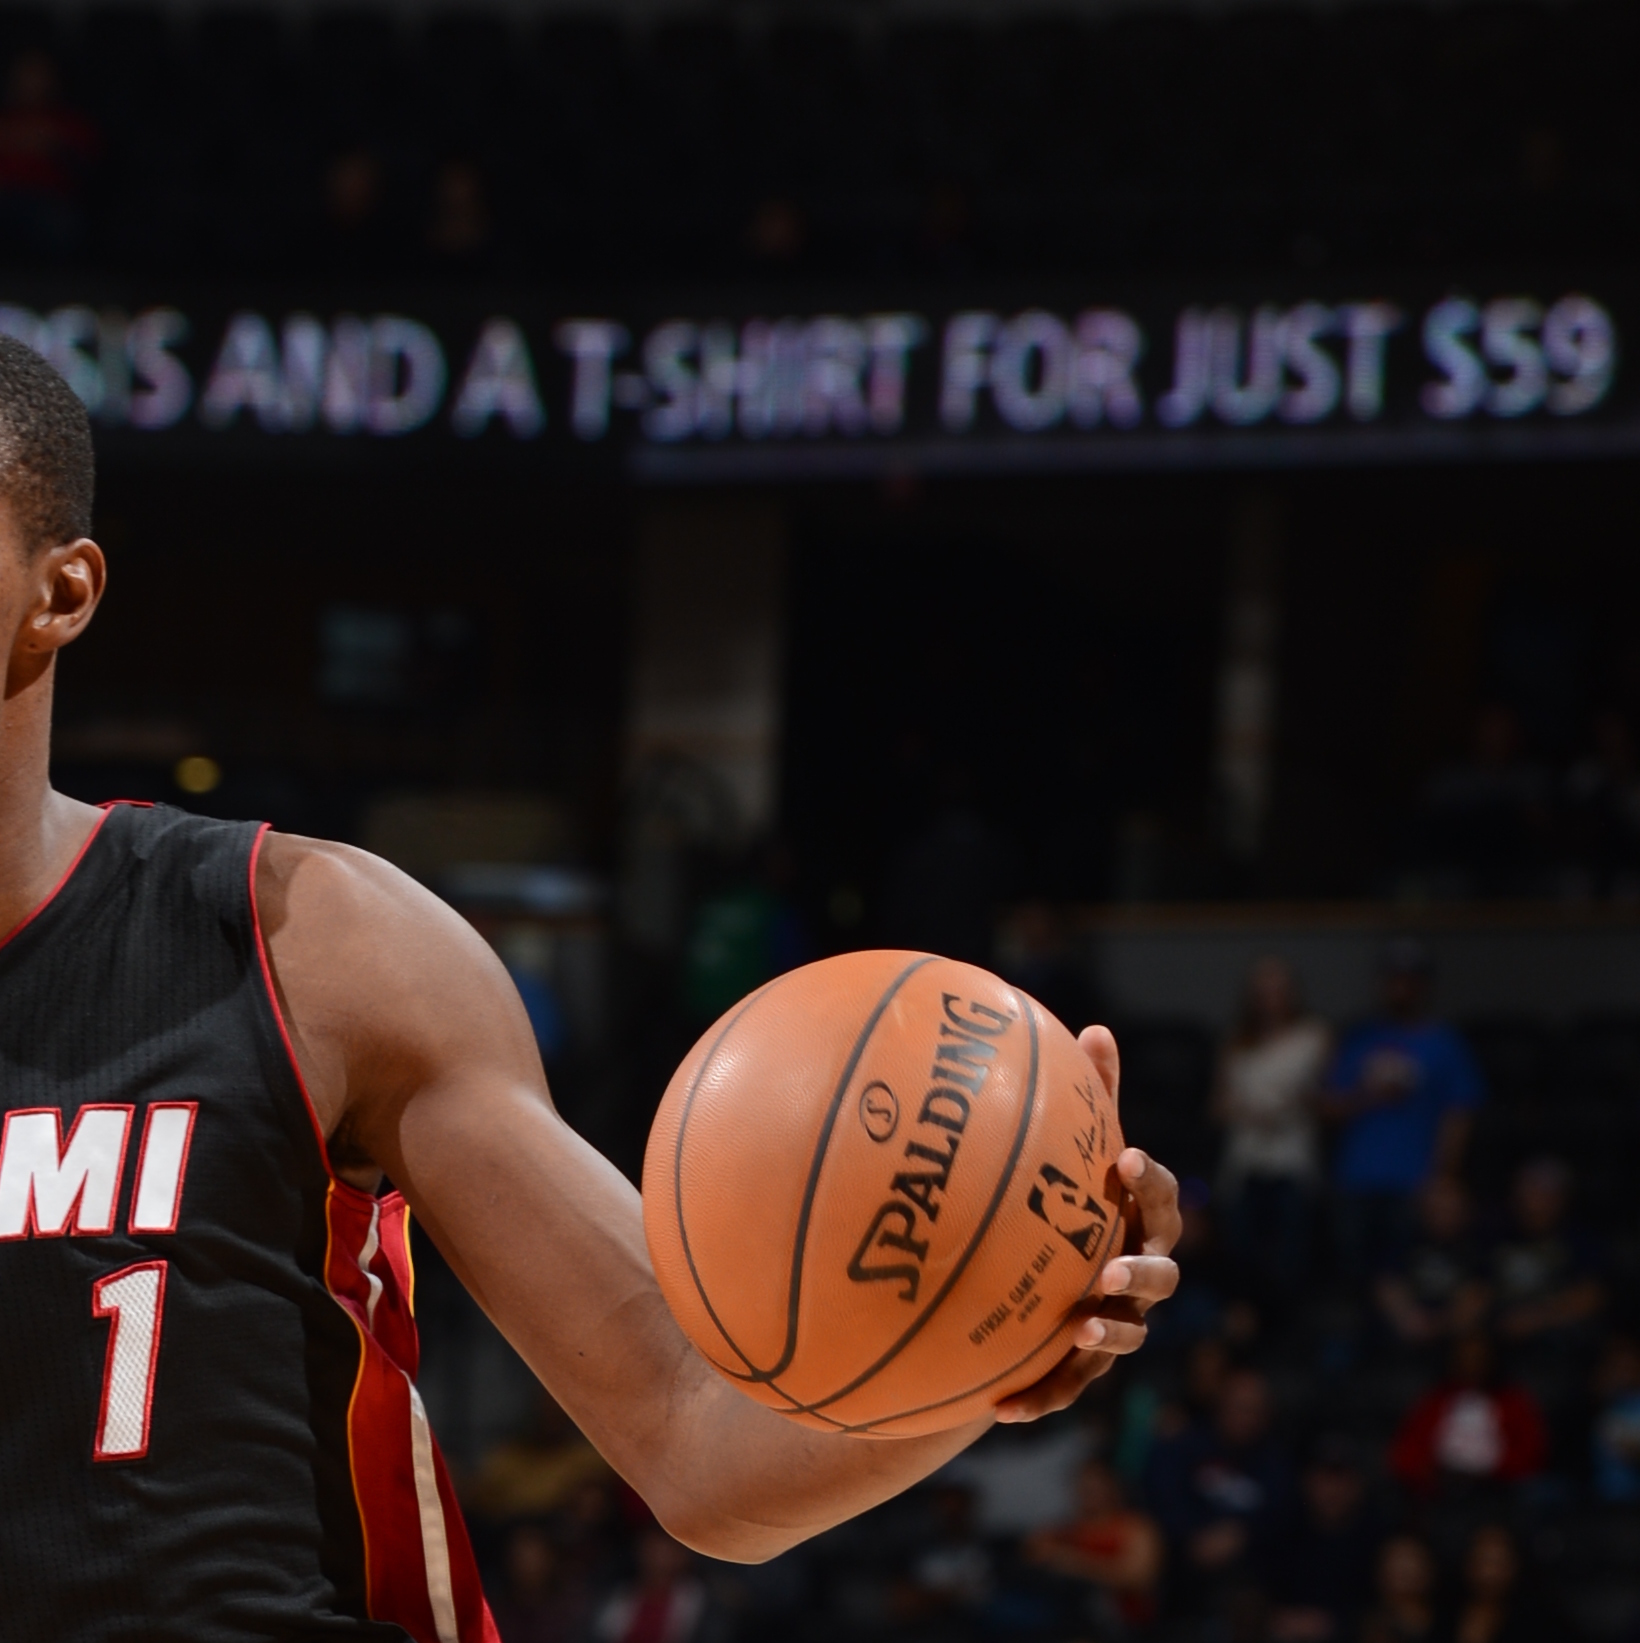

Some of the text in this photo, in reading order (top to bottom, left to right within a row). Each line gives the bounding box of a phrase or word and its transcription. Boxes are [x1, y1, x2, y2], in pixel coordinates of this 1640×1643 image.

[200, 312, 447, 435] AND
[453, 317, 546, 438] A
[554, 312, 929, 440] T-SHIRT
[939, 309, 1143, 432] FOR
[1158, 302, 1406, 427] JUST
[847, 991, 1014, 1303] SPALDING
[92, 1260, 168, 1463] 1
[969, 1243, 1055, 1344] OFFICIAL GAME BALL
